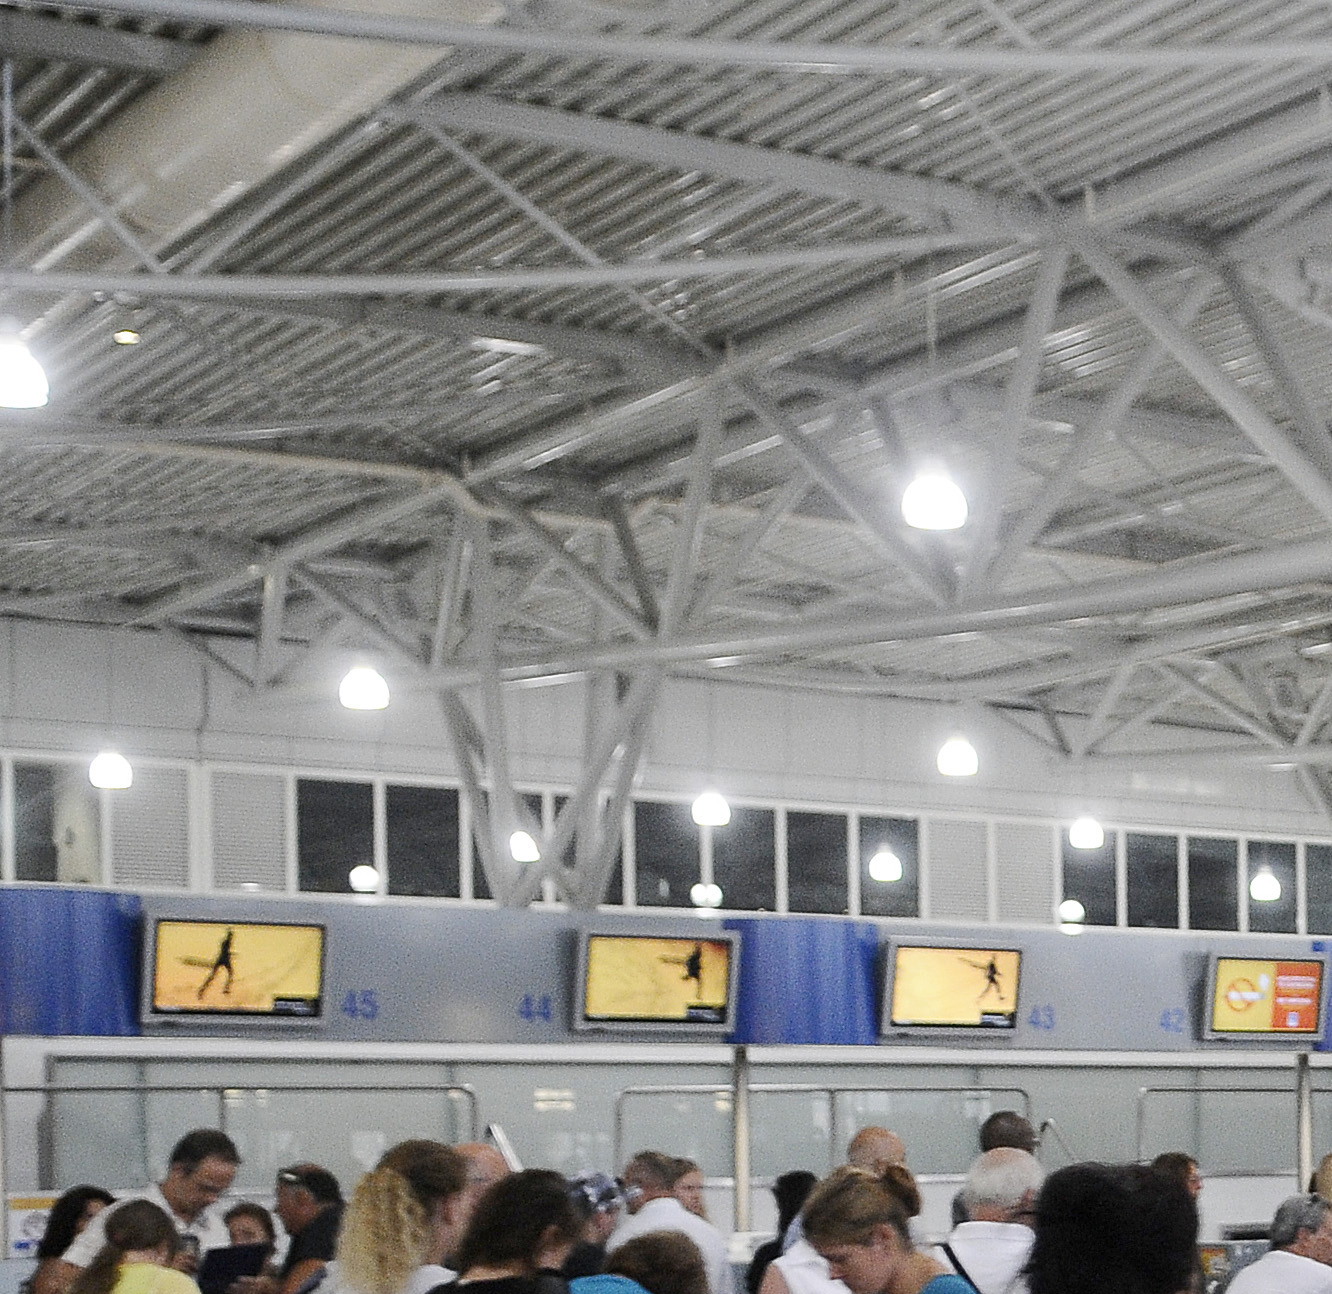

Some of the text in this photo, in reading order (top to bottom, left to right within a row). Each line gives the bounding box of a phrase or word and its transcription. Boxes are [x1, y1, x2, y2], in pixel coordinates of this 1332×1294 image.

[341, 990, 380, 1020] 45
[518, 994, 553, 1022] 44
[1027, 1003, 1056, 1030] 43
